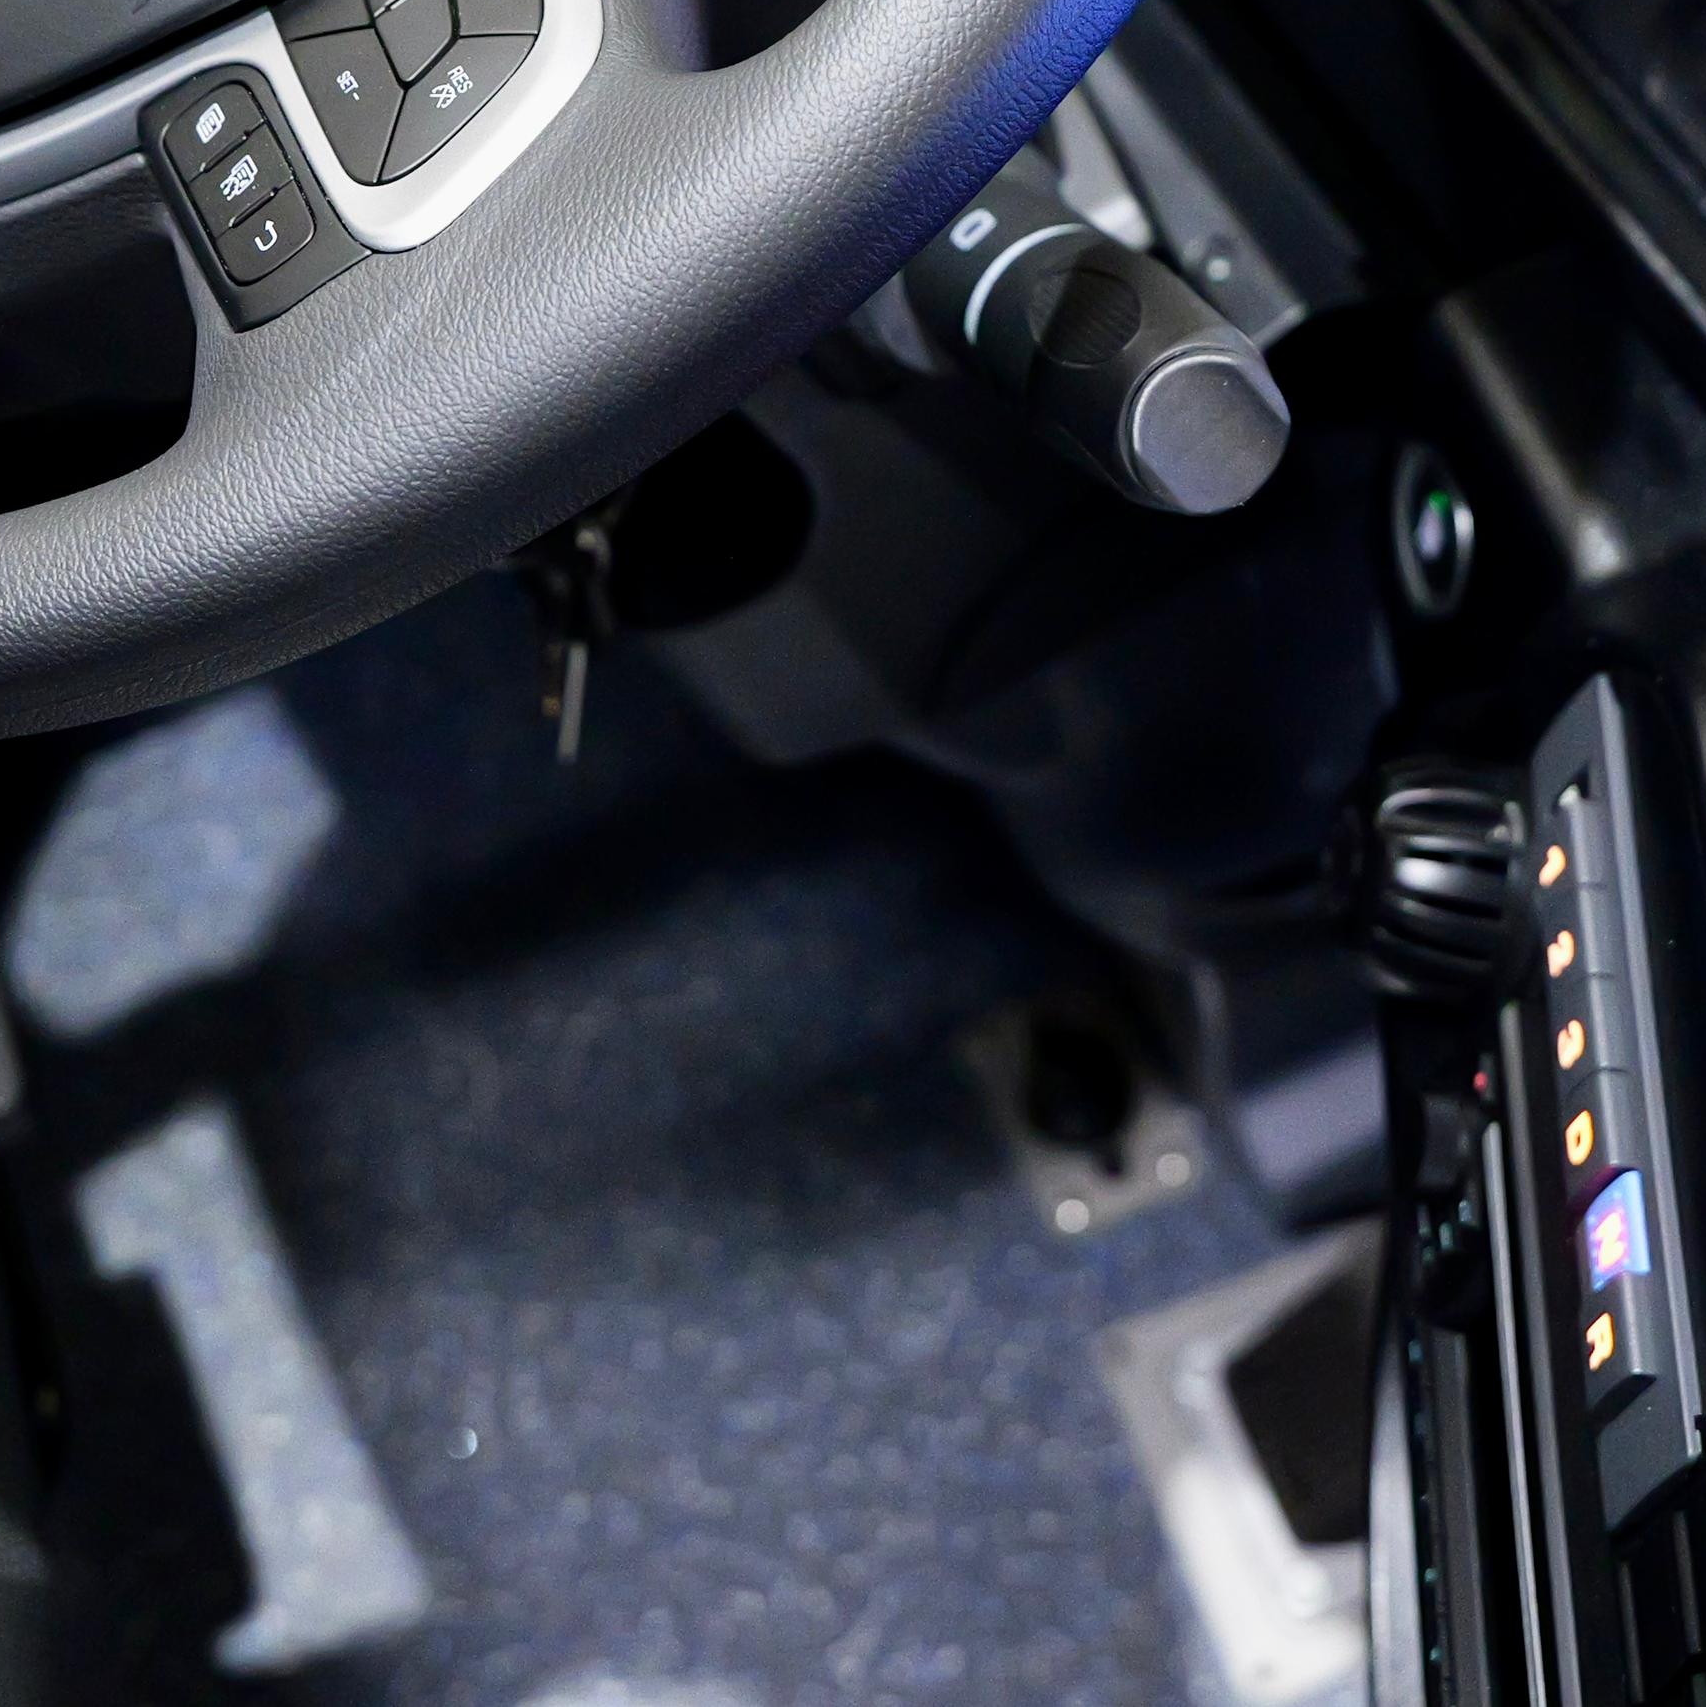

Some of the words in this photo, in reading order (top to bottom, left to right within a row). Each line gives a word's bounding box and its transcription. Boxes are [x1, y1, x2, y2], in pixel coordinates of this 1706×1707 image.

[447, 66, 473, 93] RES
[1557, 1019, 1585, 1070] 3
[1565, 1110, 1594, 1166] D
[1594, 1212, 1626, 1270] N
[1586, 1313, 1615, 1371] R
